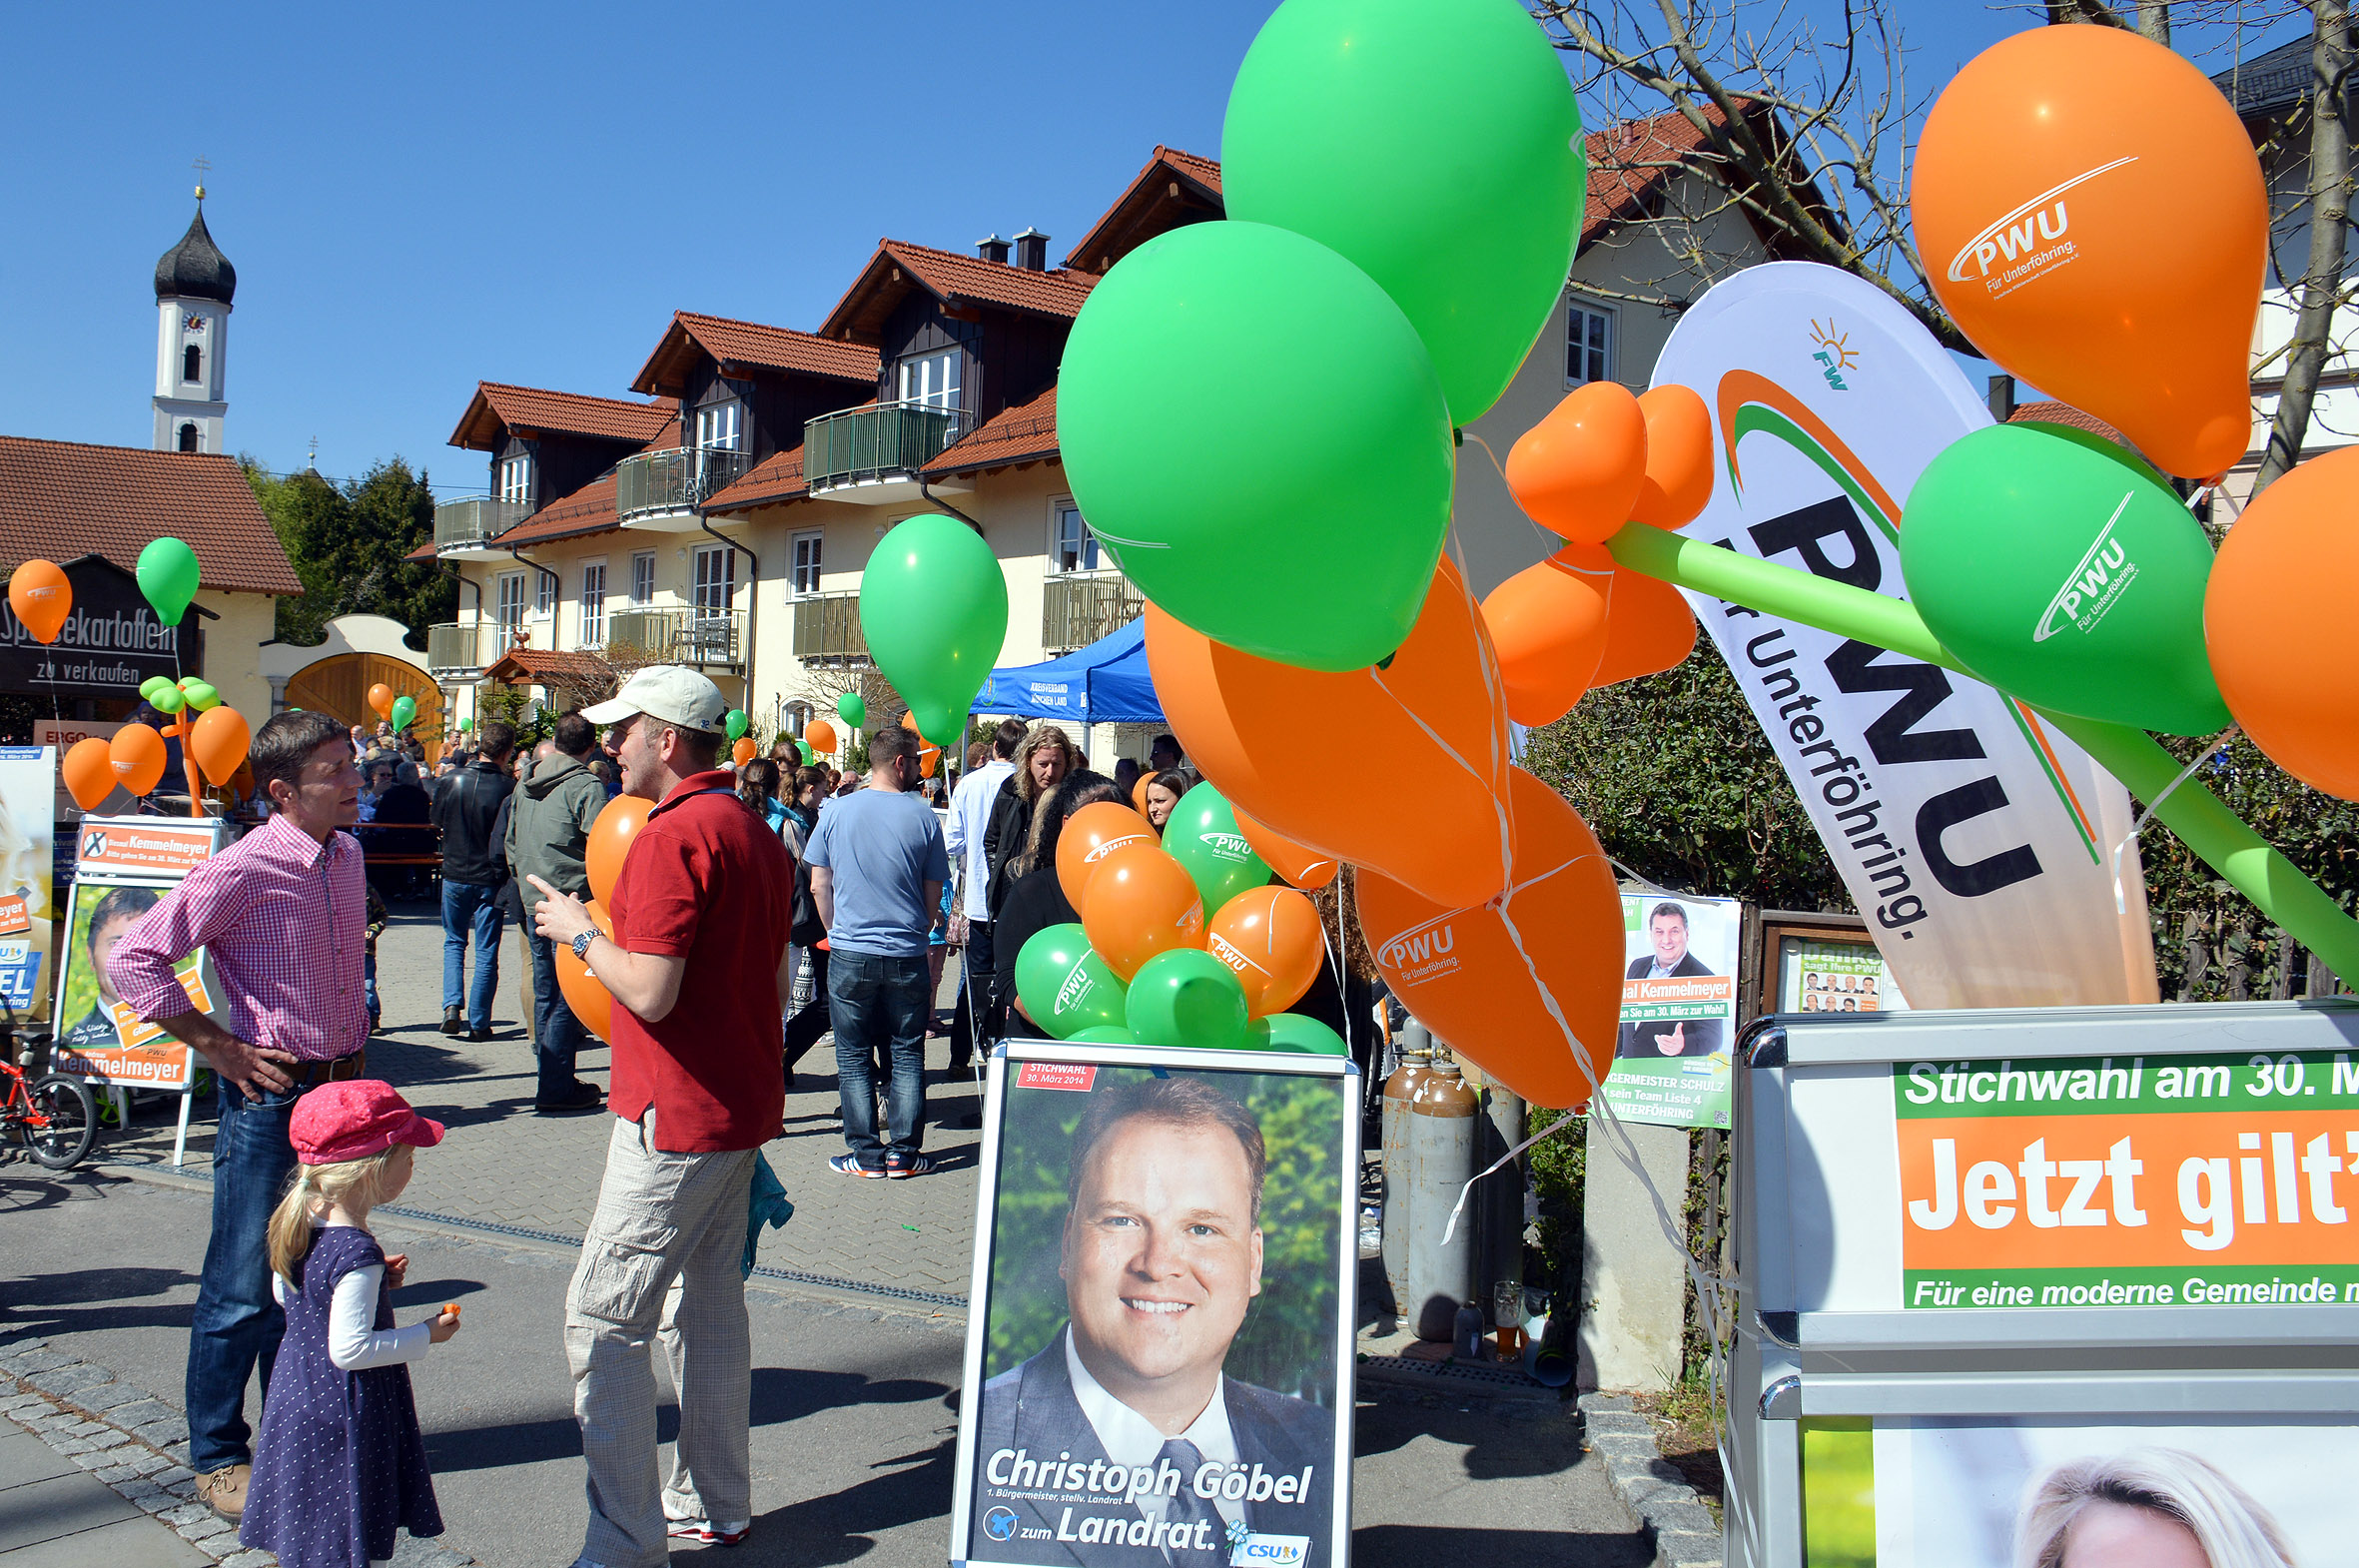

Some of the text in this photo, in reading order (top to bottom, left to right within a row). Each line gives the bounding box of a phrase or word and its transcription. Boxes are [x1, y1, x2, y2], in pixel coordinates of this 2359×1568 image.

[1973, 201, 2068, 277] PWU
[1985, 241, 2077, 294] Für Unterföhring.
[1813, 351, 1849, 391] FW
[2059, 537, 2125, 621] PWU
[2076, 613, 2092, 631] Für
[2089, 561, 2136, 616] Unterföhring.
[0, 597, 178, 650] Spekartoffeln
[37, 660, 140, 683] zu verkaufen
[1747, 494, 2044, 898] PWU
[46, 730, 88, 744] ERGO
[1746, 627, 1929, 940] Unterföhring.
[129, 835, 208, 856] Kemmelmeyer
[1214, 836, 1252, 855] PWU
[1214, 942, 1247, 971] PWU
[1392, 924, 1454, 969] PWU
[1803, 943, 1882, 965] Danke
[1400, 971, 1412, 981] Für
[1410, 956, 1460, 978] Unterföhring.
[1804, 962, 1882, 974] sagt Ihre PWU
[1061, 968, 1088, 1006] PWU
[1640, 981, 1729, 999] Kemmelmeyer
[1630, 1008, 1644, 1018] Sie
[1657, 1007, 1669, 1017] 30.
[1670, 1005, 1689, 1016] März
[1690, 1007, 1703, 1016] zur
[1704, 1004, 1725, 1015] Wahl!
[146, 1048, 168, 1057] PWU
[57, 1052, 181, 1081] Kemmelmeyer
[1026, 1074, 1085, 1085] 30. März 2014
[1030, 1063, 1088, 1075] STICHWAHL
[1904, 1057, 2144, 1105] Stichwahl
[2154, 1065, 2231, 1100] am
[2244, 1054, 2315, 1097] 30.
[1609, 1089, 1633, 1099] sein
[1635, 1090, 1663, 1102] Team
[1665, 1093, 1692, 1105] Liste
[1694, 1095, 1702, 1106] 4
[1680, 1079, 1726, 1093] SCHULZ
[1610, 1101, 1694, 1120] UNTERFÖHRING
[1908, 1135, 2148, 1230] Jetzt
[1914, 1280, 1966, 1305] Für
[1971, 1280, 2033, 1305] eine
[2041, 1279, 2174, 1304] moderne
[2182, 1276, 2337, 1303] Gemeinde
[986, 1448, 1314, 1504] Christoph Göbel
[987, 1488, 1124, 1505] 1. Bürgermeister, stellv. Landrat
[1020, 1506, 1217, 1551] zum Landrat.
[1246, 1544, 1283, 1559] CSU
